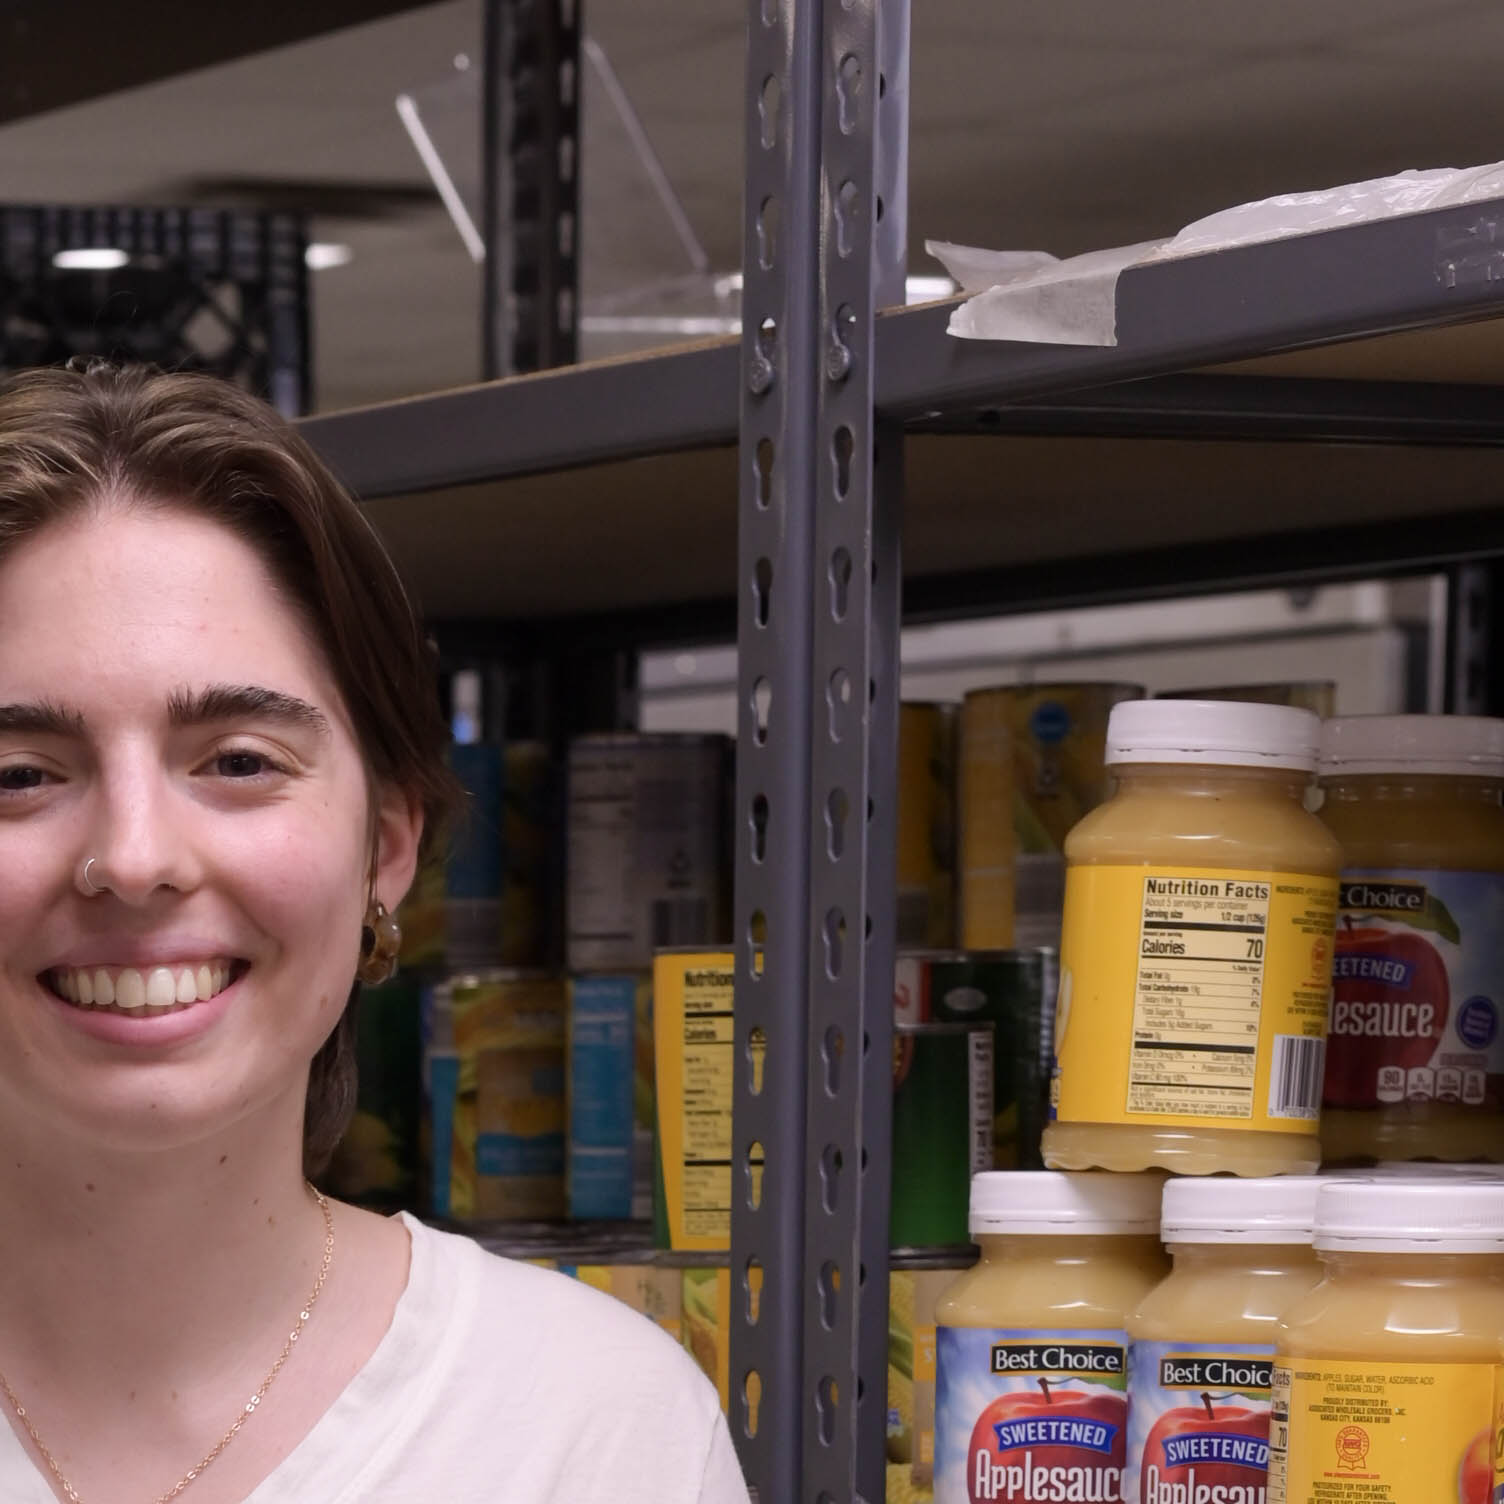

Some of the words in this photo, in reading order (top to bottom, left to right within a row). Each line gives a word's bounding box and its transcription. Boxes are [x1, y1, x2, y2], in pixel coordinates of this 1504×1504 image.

[1147, 879, 1219, 896] Nutrition
[1225, 882, 1268, 899] Facts
[1347, 886, 1421, 909] Choice
[1142, 939, 1185, 954] Calories
[1247, 938, 1263, 958] 70
[1331, 957, 1405, 983] EETENED
[1327, 990, 1434, 1037] lesauce
[996, 1350, 1038, 1370] Best
[1042, 1348, 1118, 1371] Choice
[1163, 1363, 1202, 1384] Best
[1000, 1421, 1107, 1446] SWEETENED
[1278, 1427, 1287, 1447] 70
[1167, 1438, 1268, 1465] SWEETENED
